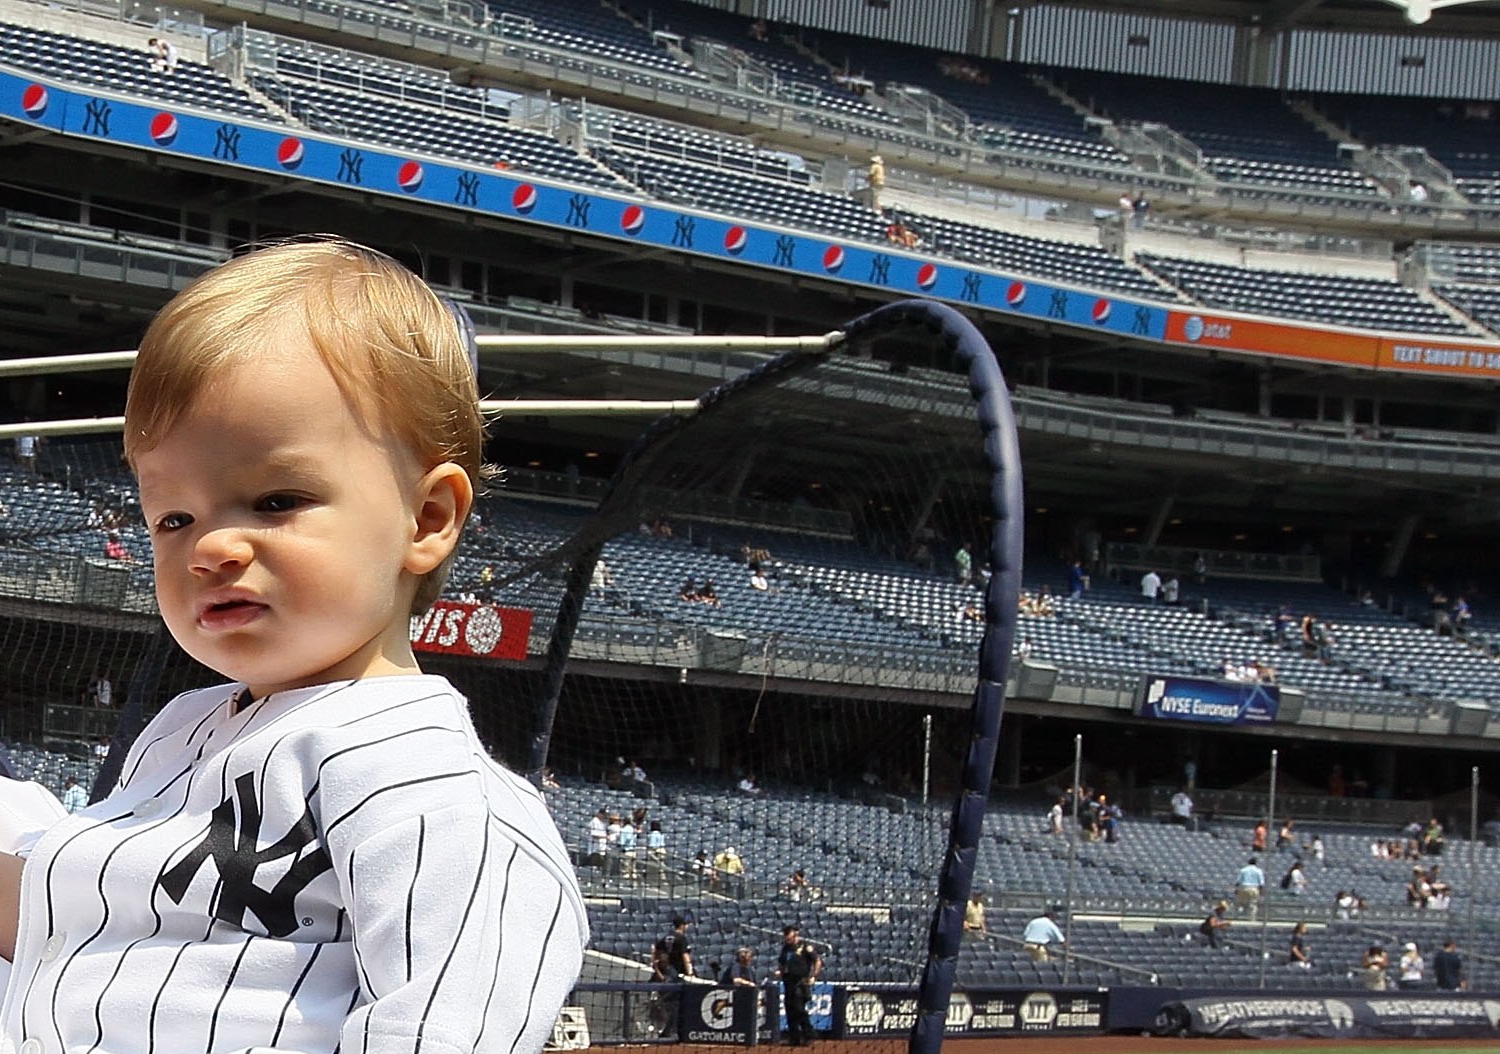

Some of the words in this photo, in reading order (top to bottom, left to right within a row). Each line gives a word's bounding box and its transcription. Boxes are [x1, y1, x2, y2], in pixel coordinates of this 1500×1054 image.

[409, 607, 466, 647] VIS
[1161, 695, 1192, 715] NYSE
[1192, 697, 1240, 719] Euronext
[160, 771, 333, 938] NY
[1197, 999, 1326, 1025] WEATHERPROOF
